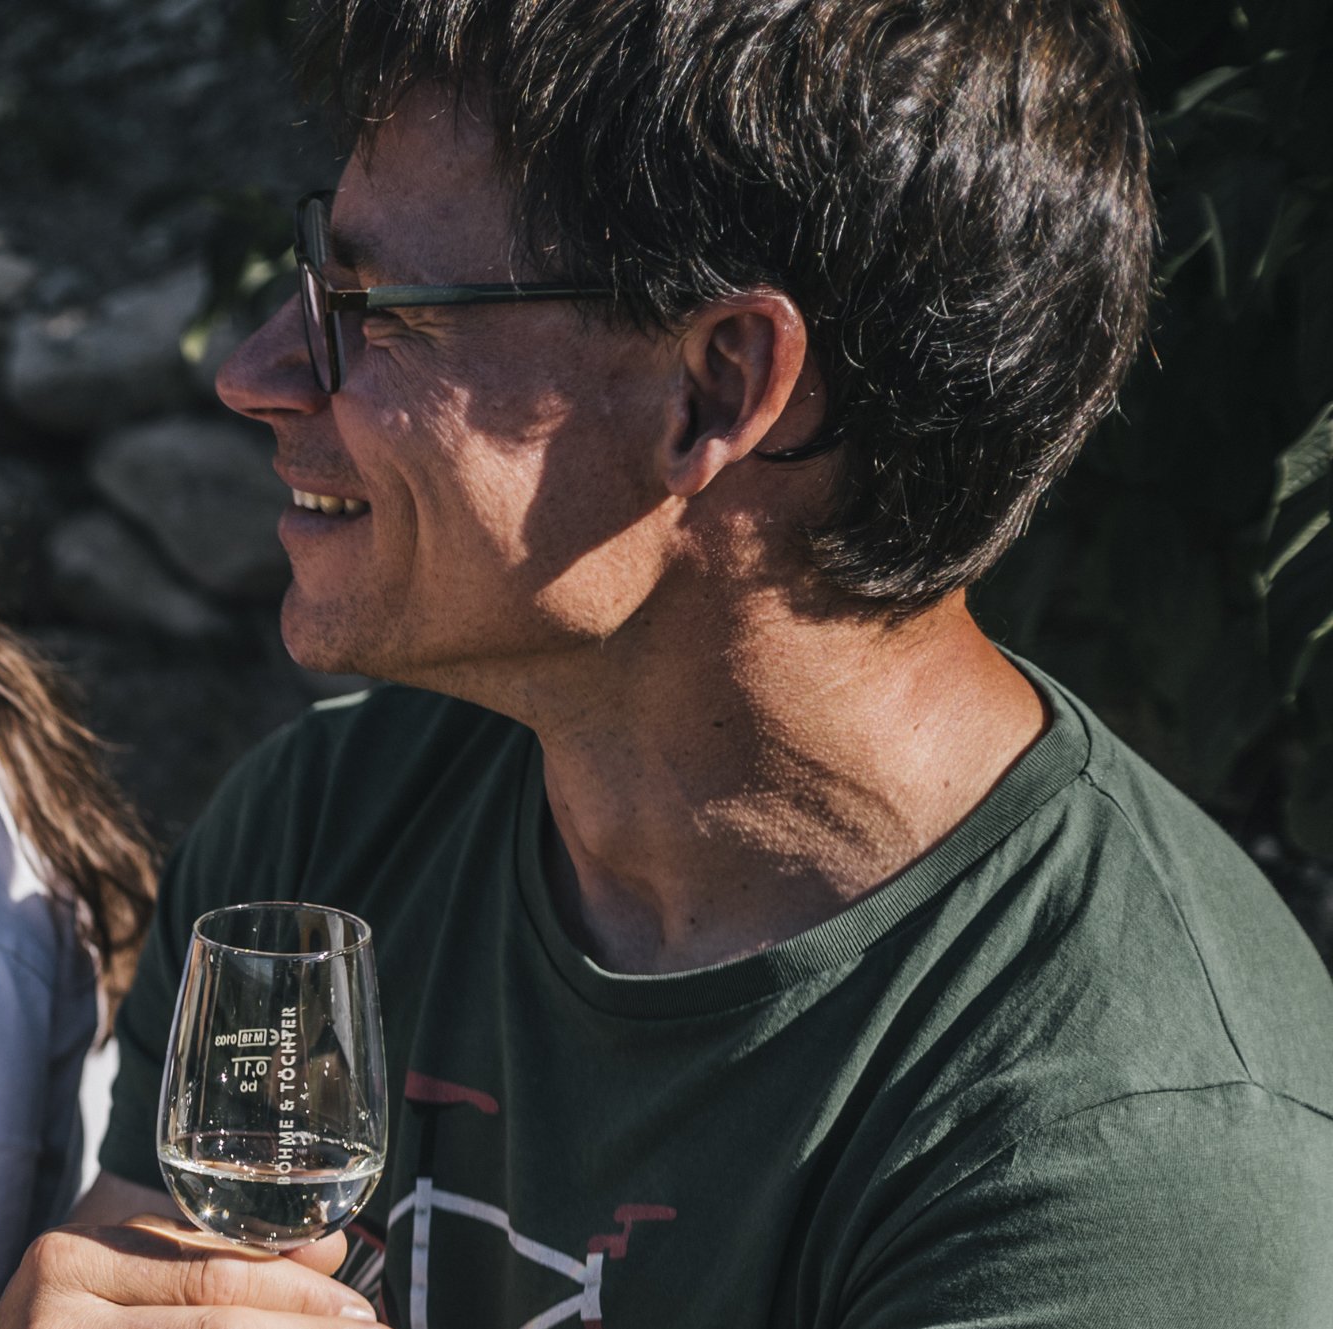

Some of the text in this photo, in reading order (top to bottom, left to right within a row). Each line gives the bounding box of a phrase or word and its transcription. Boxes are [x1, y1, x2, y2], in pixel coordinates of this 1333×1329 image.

[276, 1006, 297, 1185] BÖHME & TÖCHTER
